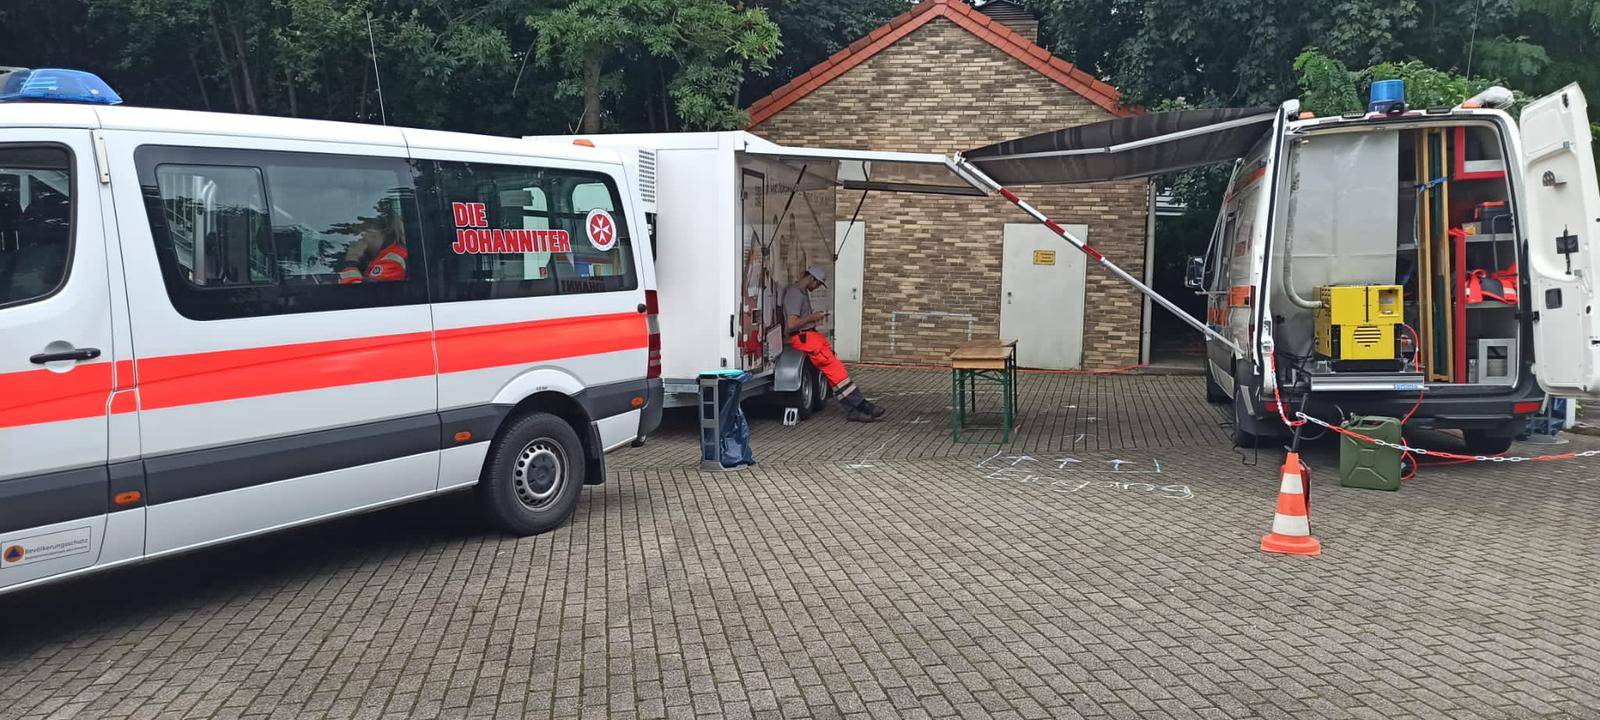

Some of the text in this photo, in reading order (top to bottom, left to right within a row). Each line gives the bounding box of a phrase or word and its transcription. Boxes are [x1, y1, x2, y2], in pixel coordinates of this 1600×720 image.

[452, 202, 488, 227] DIE
[452, 229, 571, 254] JOHANNITER
[26, 538, 88, 553] Bevölkerungsschutz
